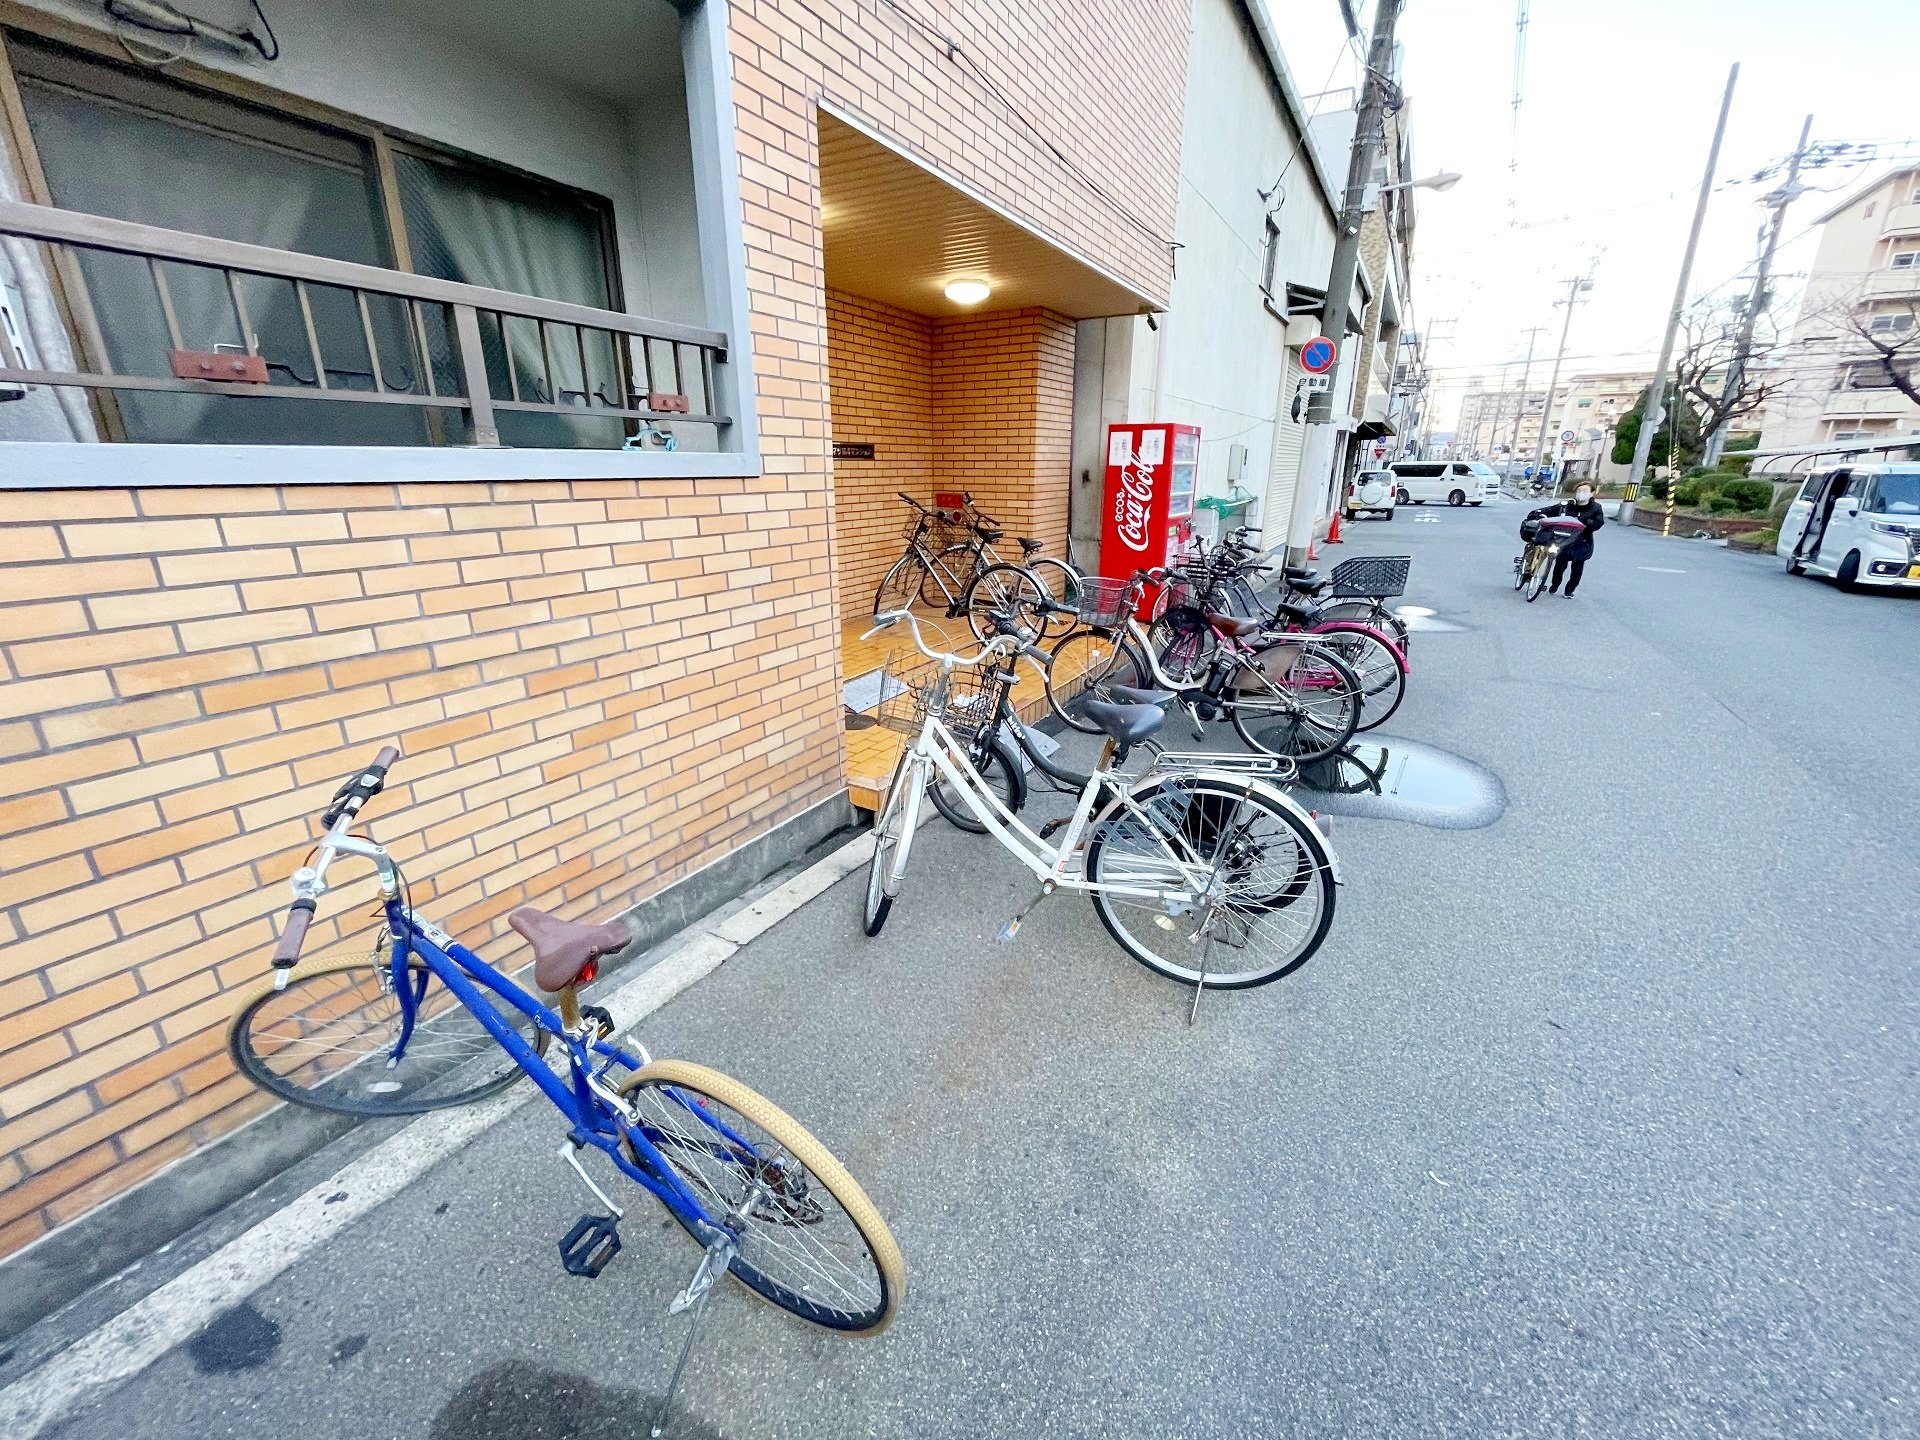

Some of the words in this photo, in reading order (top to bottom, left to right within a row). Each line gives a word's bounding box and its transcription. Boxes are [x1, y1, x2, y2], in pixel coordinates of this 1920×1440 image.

[1299, 377, 1327, 387] 自動車
[1118, 446, 1154, 551] Coca-Col
